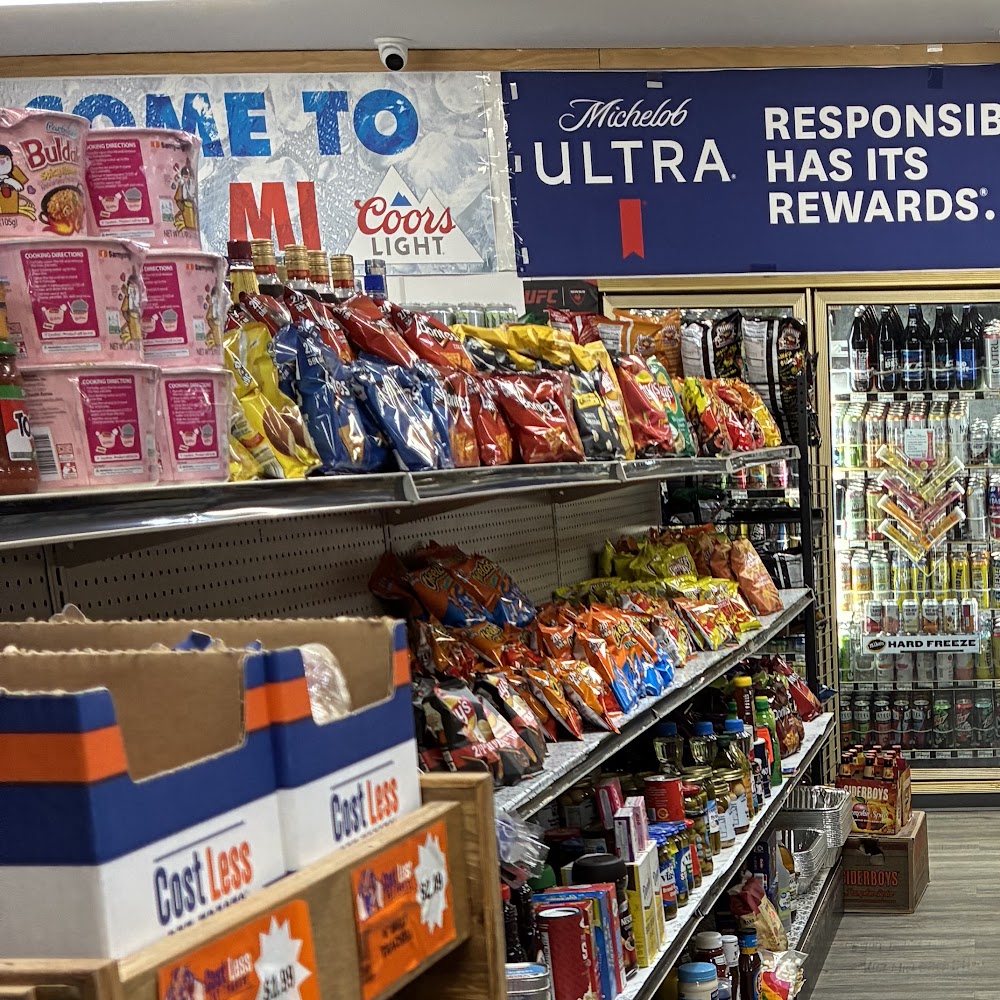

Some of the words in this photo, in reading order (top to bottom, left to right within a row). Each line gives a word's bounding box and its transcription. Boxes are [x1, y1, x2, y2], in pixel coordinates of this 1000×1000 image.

[302, 89, 419, 156] TO
[558, 98, 691, 132] Michelob
[533, 139, 731, 185] ULTRA
[767, 150, 852, 182] HAS
[868, 147, 928, 181] ITS
[229, 181, 321, 250] MI
[355, 197, 456, 236] Coors
[371, 236, 445, 256] LIGHT
[524, 289, 558, 305] UFC
[888, 640, 924, 648] HARD
[927, 639, 976, 648] FREEZE
[330, 785, 367, 842] Cost
[366, 776, 399, 825] Less
[154, 851, 204, 927] Cost
[205, 841, 255, 901] Less
[396, 856, 413, 884] Less
[225, 947, 252, 983] Less
